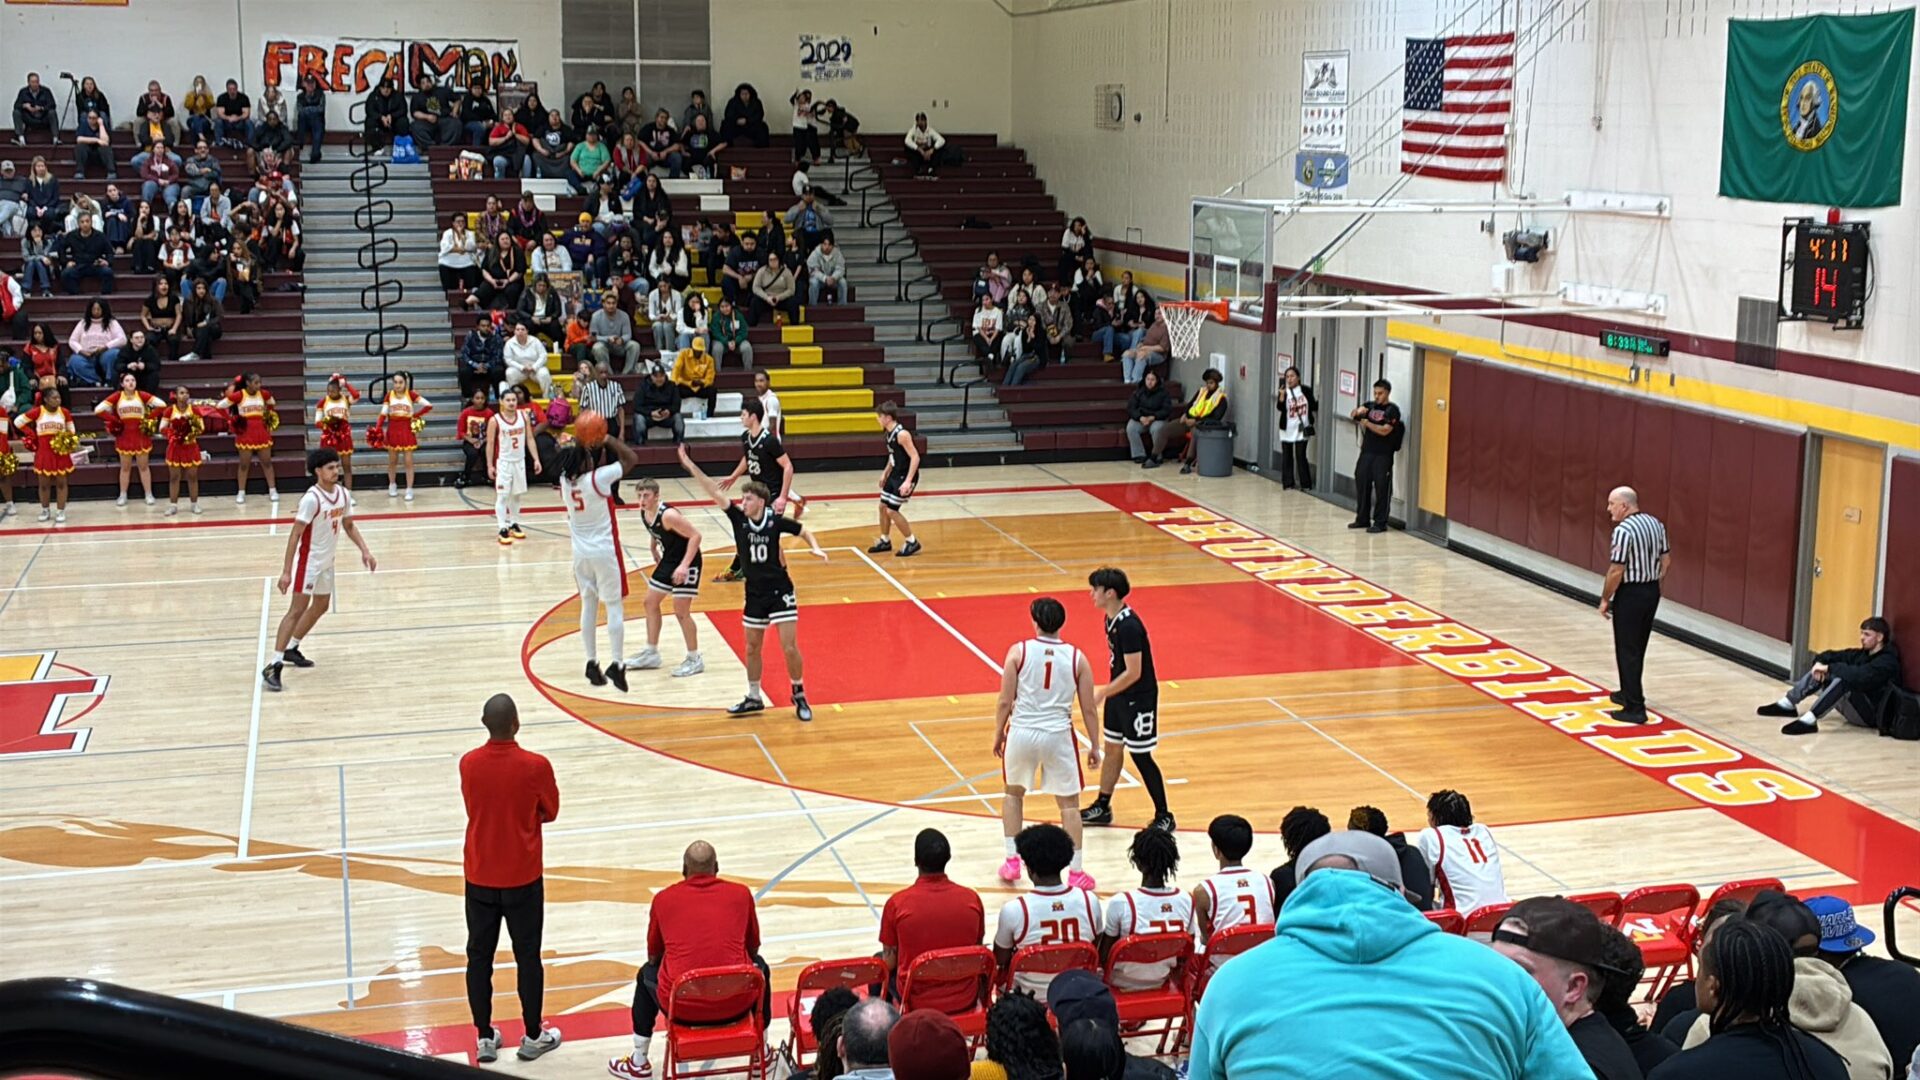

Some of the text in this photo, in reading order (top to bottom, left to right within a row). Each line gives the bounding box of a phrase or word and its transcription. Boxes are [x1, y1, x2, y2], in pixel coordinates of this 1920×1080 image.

[800, 40, 852, 64] 2029
[1809, 238, 1849, 263] 4:11
[1814, 267, 1840, 309] 14
[511, 437, 519, 449] 2
[571, 490, 585, 511] 5
[332, 520, 338, 535] 4
[749, 544, 769, 563] 10
[1131, 506, 1824, 806] THUNDERBIRDS
[1043, 661, 1053, 691] 1
[1462, 838, 1488, 864] 11
[1236, 895, 1257, 925] 3
[1040, 917, 1080, 946] 20
